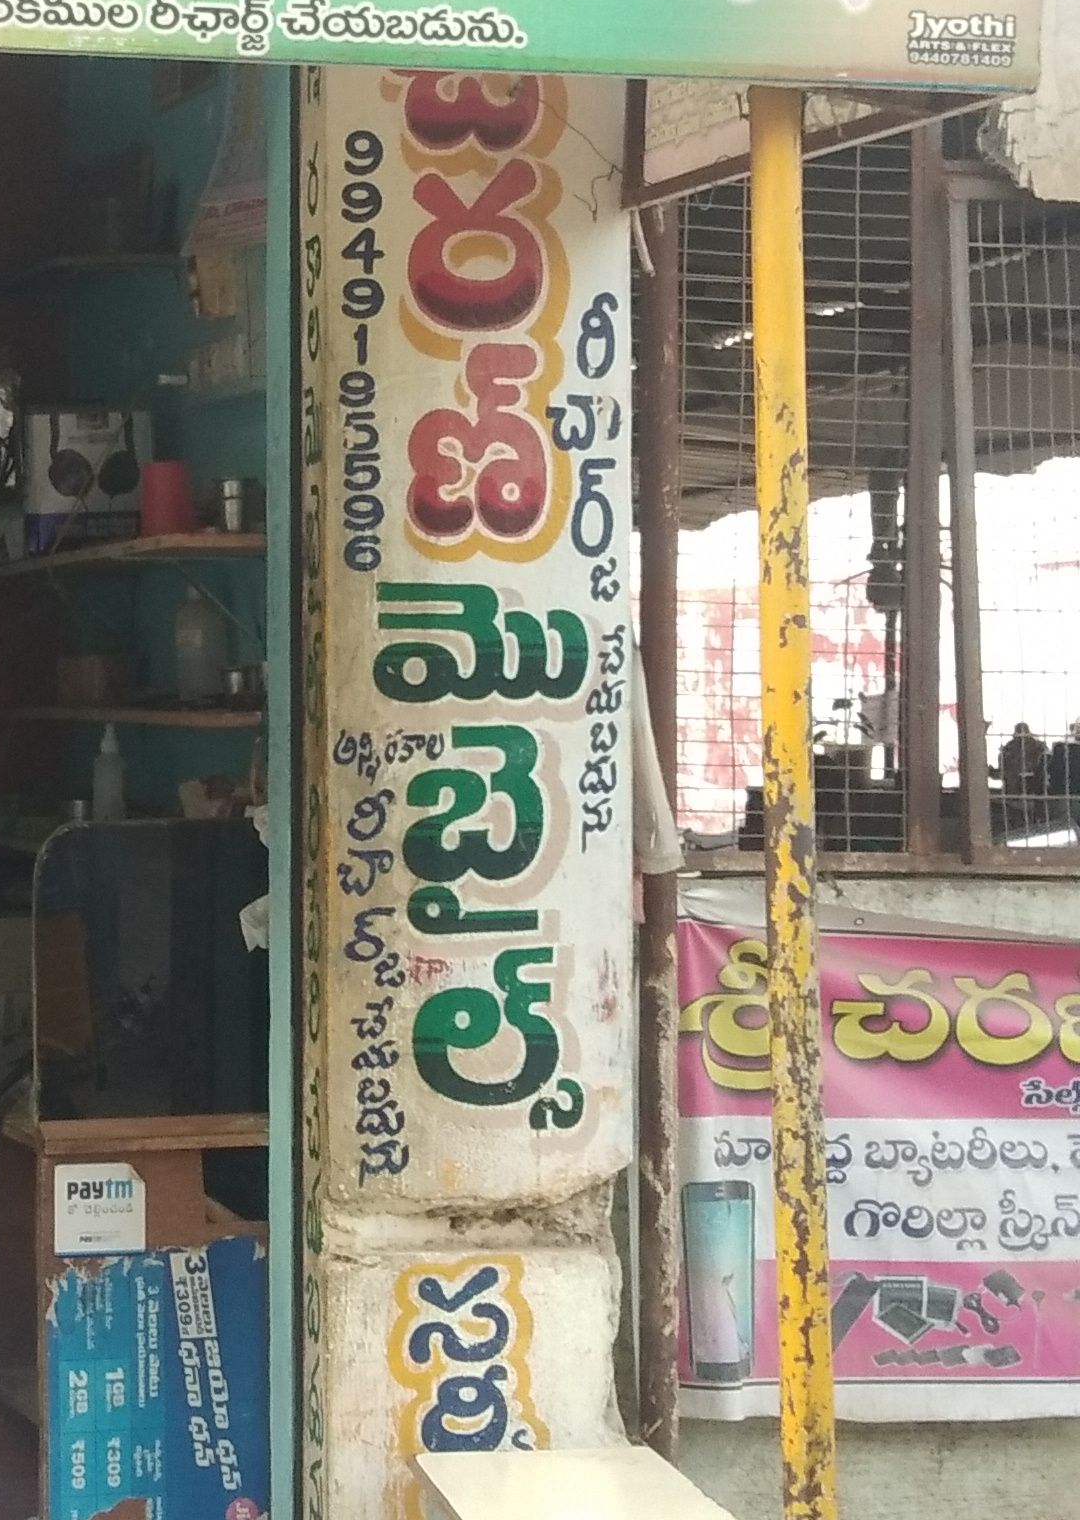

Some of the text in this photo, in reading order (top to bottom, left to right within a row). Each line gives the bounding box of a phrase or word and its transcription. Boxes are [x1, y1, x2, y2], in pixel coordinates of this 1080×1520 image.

[908, 41, 951, 52] ARTS
[972, 42, 1012, 54] FLEX
[909, 13, 1016, 40] Jyothi
[339, 130, 385, 573] 9949195596
[831, 968, 1080, 1067] చర
